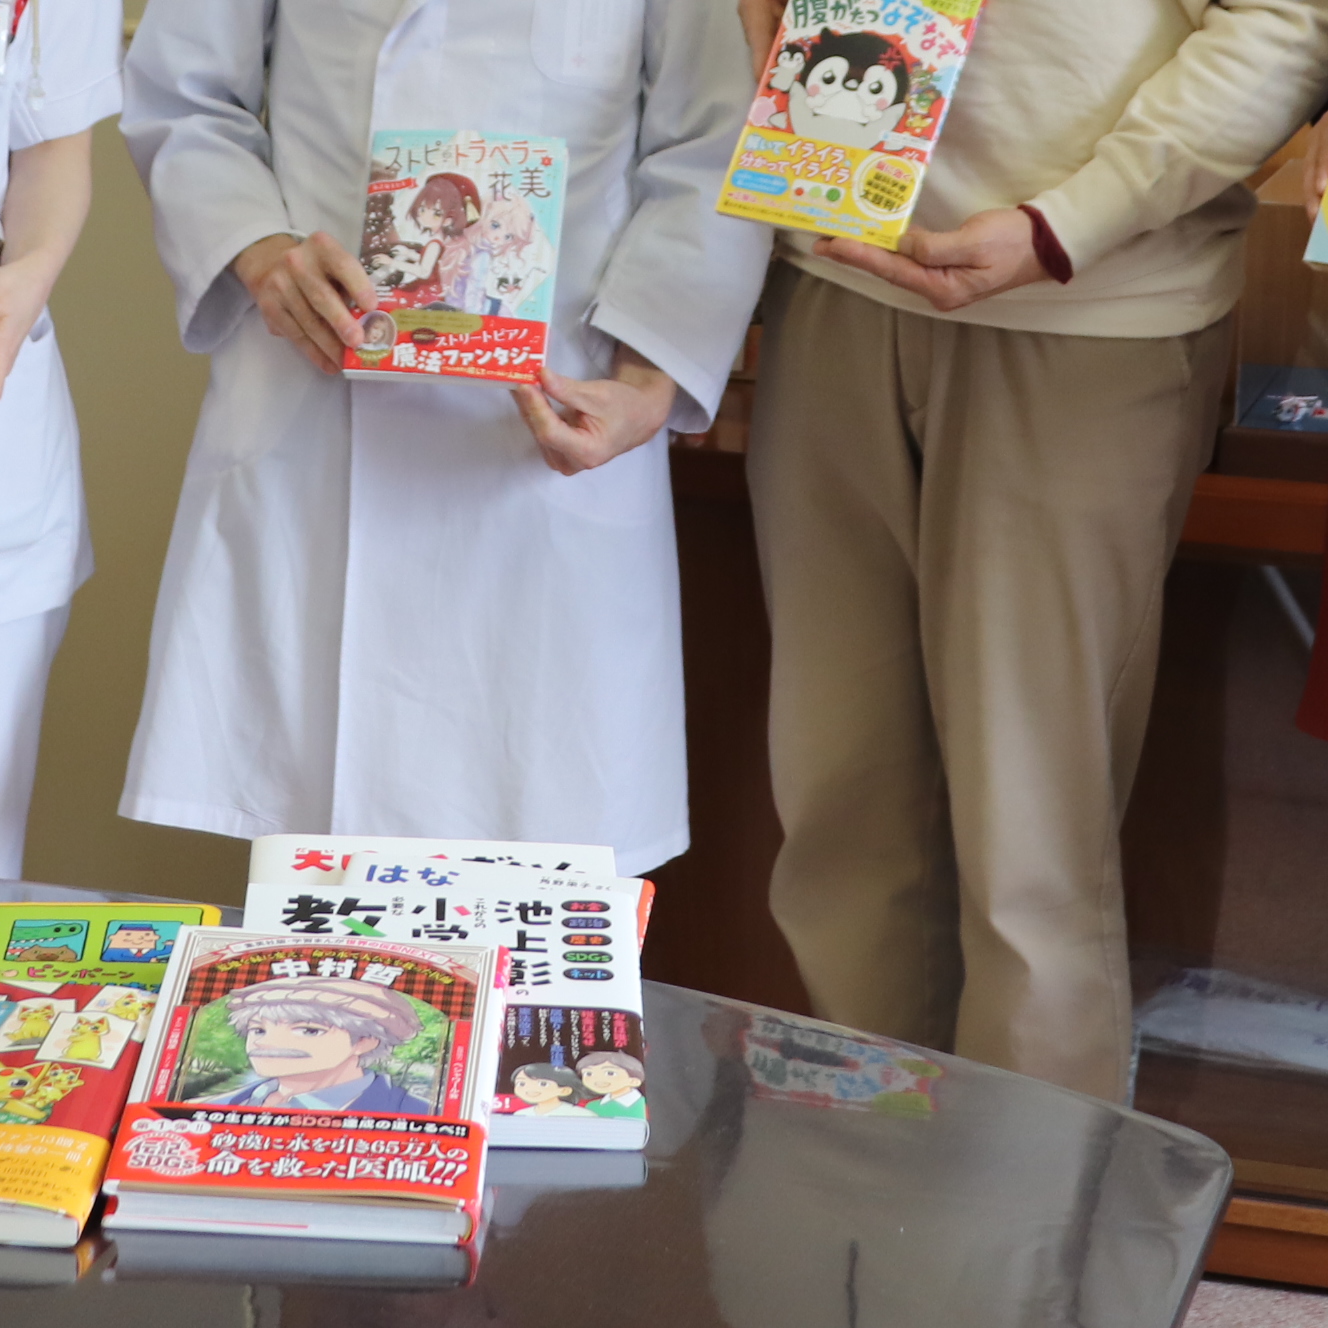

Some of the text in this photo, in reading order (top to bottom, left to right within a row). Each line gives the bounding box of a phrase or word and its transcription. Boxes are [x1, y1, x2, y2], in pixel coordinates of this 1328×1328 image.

[488, 167, 552, 201] 花美
[435, 328, 529, 347] ストリートピアノ
[392, 343, 545, 373] 魔法ファンタジー
[569, 901, 603, 912] お金
[571, 934, 605, 945] 歴史
[566, 951, 611, 963] SDGs
[28, 965, 134, 979] ピンポーン
[271, 957, 404, 987] 中村哲
[571, 969, 607, 980] ネット
[207, 1149, 469, 1188] 命を救った医師!!!
